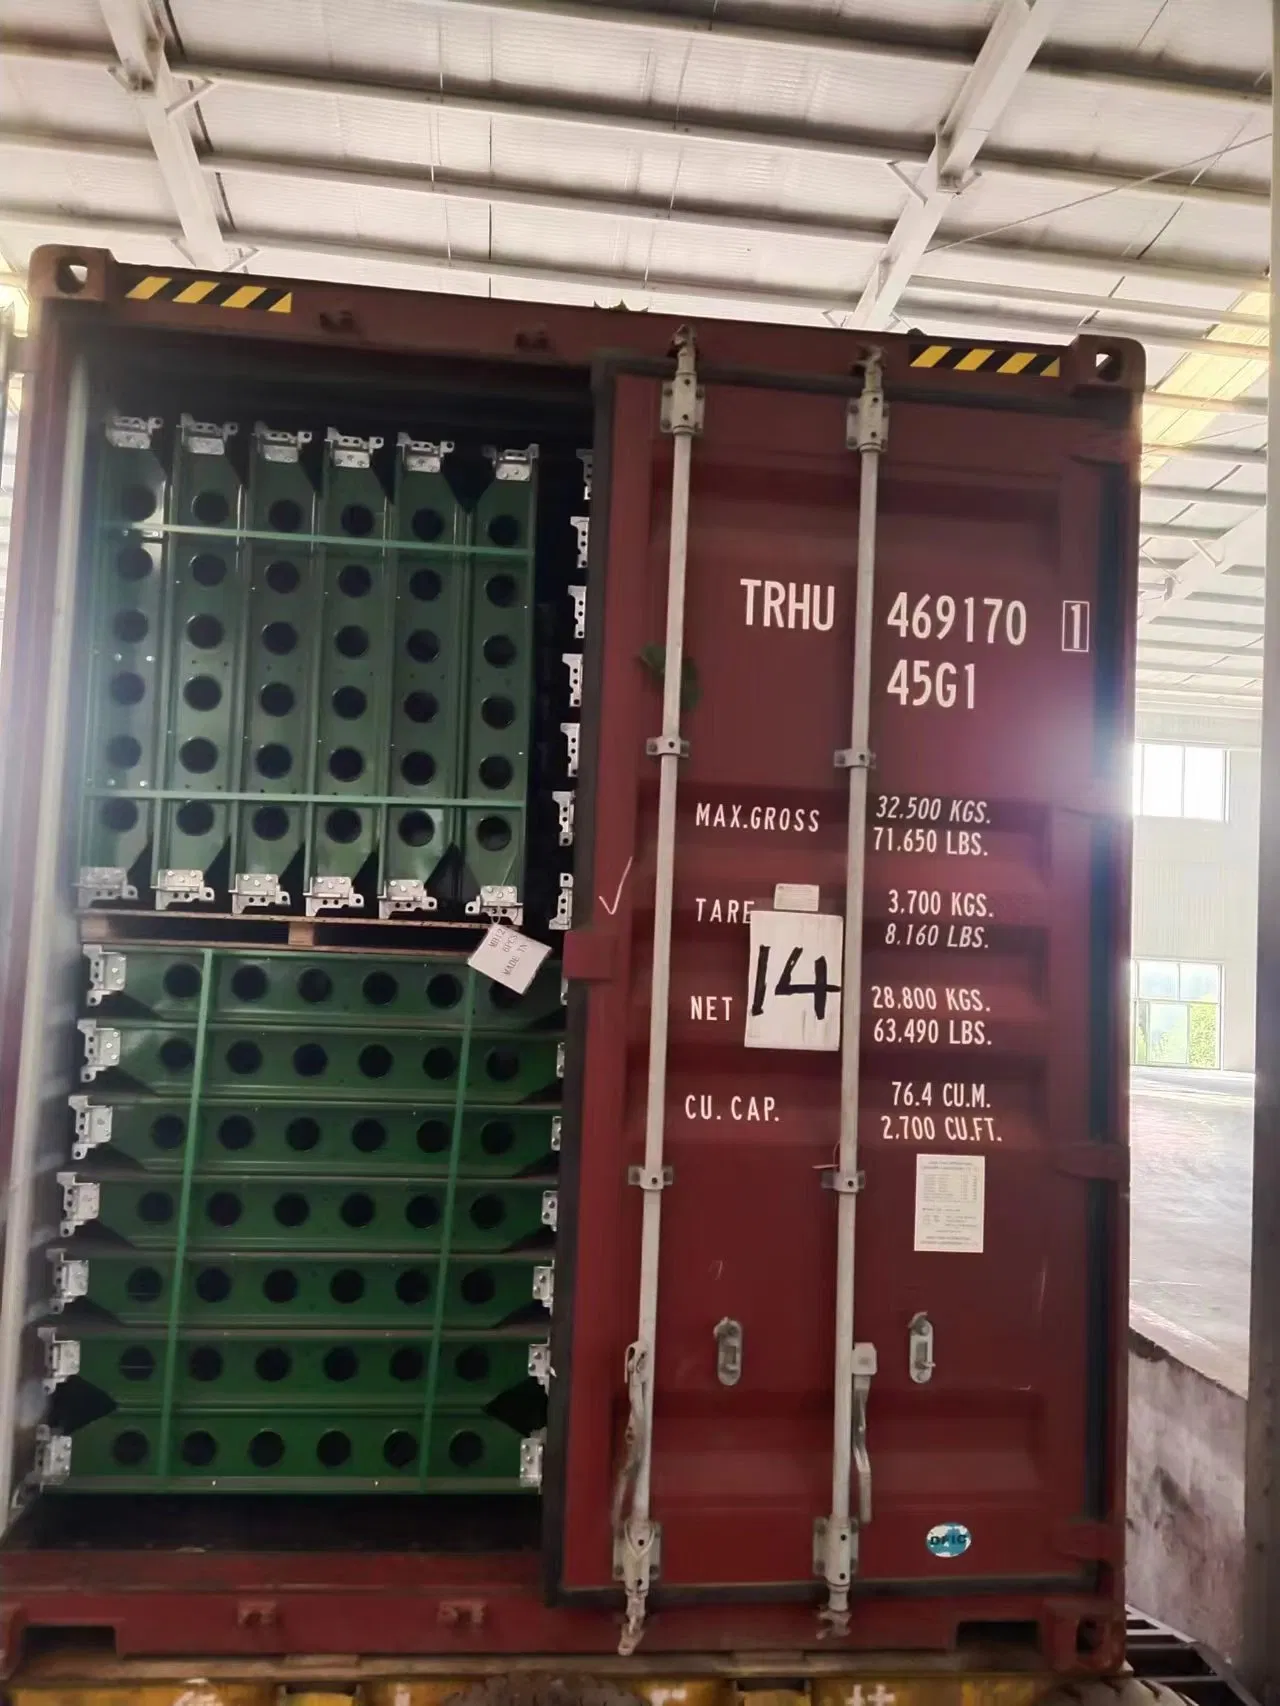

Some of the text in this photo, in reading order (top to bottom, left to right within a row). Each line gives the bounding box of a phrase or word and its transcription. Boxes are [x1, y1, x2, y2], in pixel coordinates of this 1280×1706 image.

[740, 579, 835, 631] TRHU
[887, 592, 1027, 646] 469170
[887, 659, 975, 709] 45G1
[695, 802, 820, 832] MAX.GROSS
[949, 799, 991, 824] KGS.
[946, 830, 989, 856] LBS.
[695, 898, 755, 924] TARE
[951, 891, 994, 918] KGS.
[946, 924, 989, 949] LBS.
[751, 944, 842, 1021] 14
[690, 995, 733, 1021] NET
[945, 987, 991, 1012] KGS.
[949, 1019, 993, 1046] LBS.
[730, 1095, 780, 1122] CAP.
[891, 1081, 932, 1107] 76.4
[942, 1082, 992, 1109] CU.M.
[944, 1116, 1003, 1141] CU.FT.
